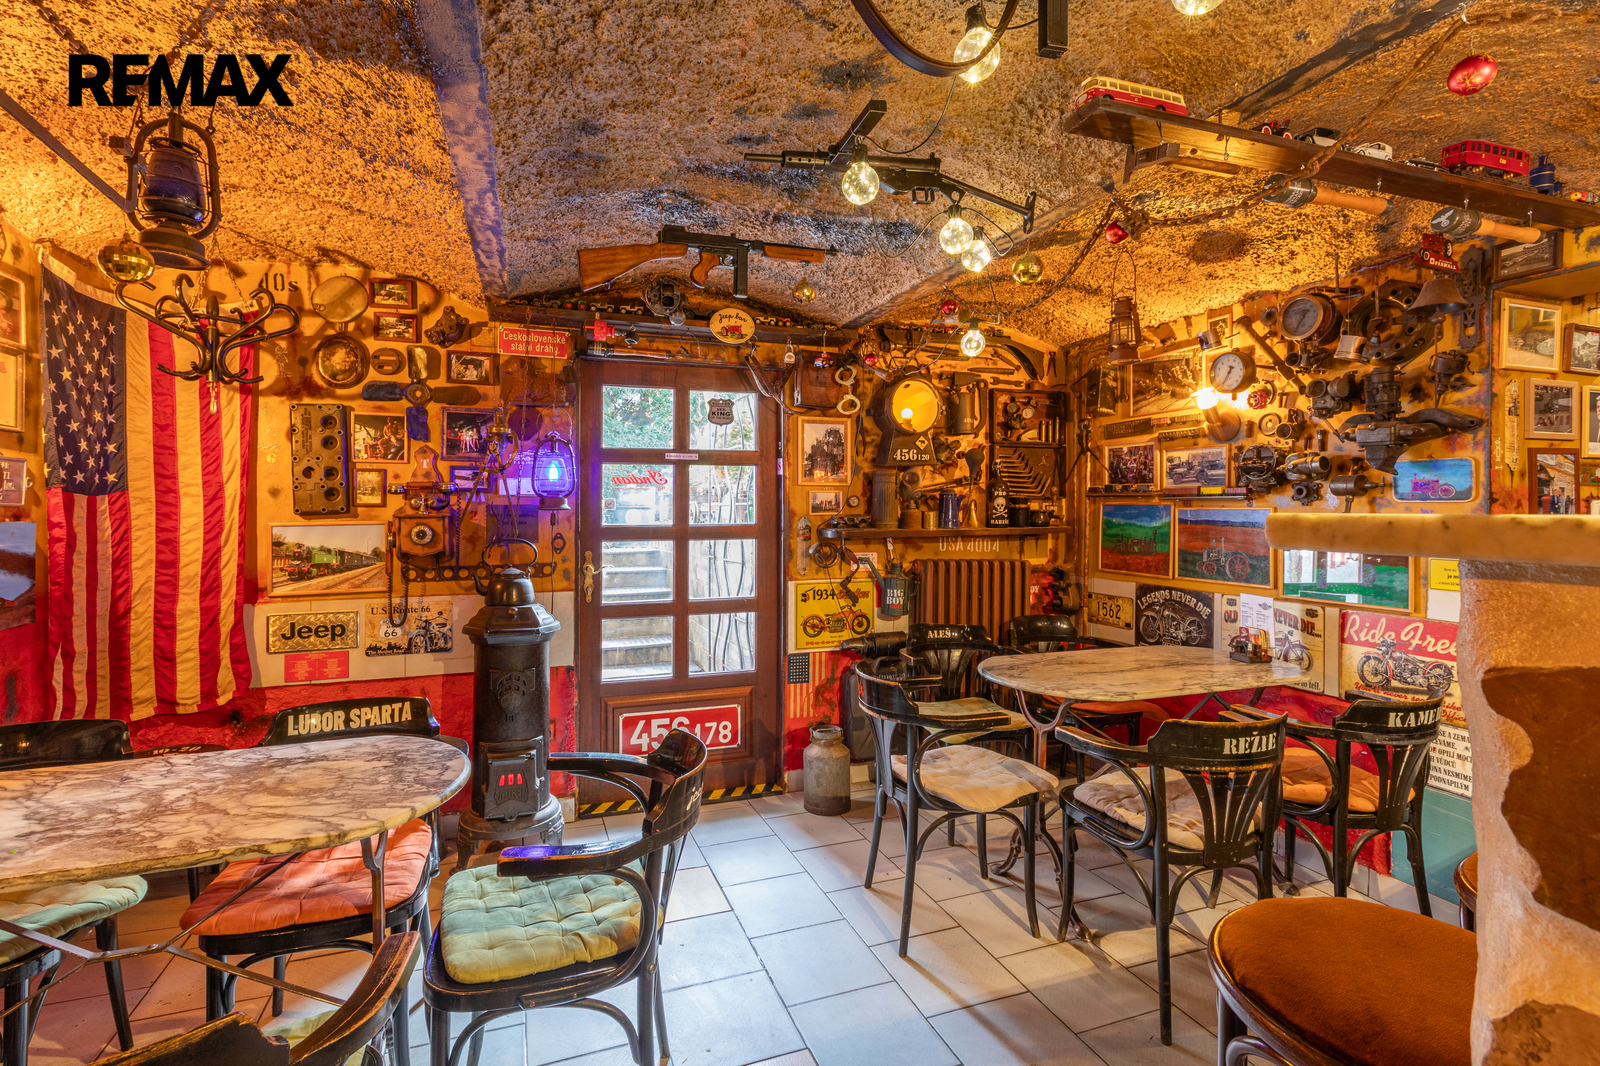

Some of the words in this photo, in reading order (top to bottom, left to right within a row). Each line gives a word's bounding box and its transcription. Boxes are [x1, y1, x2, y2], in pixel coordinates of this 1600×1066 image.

[893, 448, 917, 461] 456
[939, 536, 964, 551] USA
[967, 537, 1000, 552] 4004
[812, 588, 836, 600] 1934
[886, 588, 904, 597] BIG
[886, 597, 905, 605] BOY
[421, 604, 431, 613] 66
[1097, 601, 1121, 620] 1562
[1137, 589, 1170, 610] LEGENDS
[1172, 590, 1197, 609] NEVER
[1195, 601, 1212, 620] DIE
[1223, 609, 1239, 624] OLD
[280, 621, 346, 642] Jeep
[384, 628, 398, 637] 66
[927, 627, 951, 639] ALEŠ
[1343, 613, 1397, 644] Ride
[1354, 681, 1382, 695] You'll
[1383, 690, 1409, 700] never
[287, 710, 346, 736] LUBOR
[349, 701, 412, 729] SPARTA
[694, 720, 732, 745] 178
[1222, 731, 1277, 755] REŽIE
[1429, 773, 1470, 791] PODNAPILÝM
